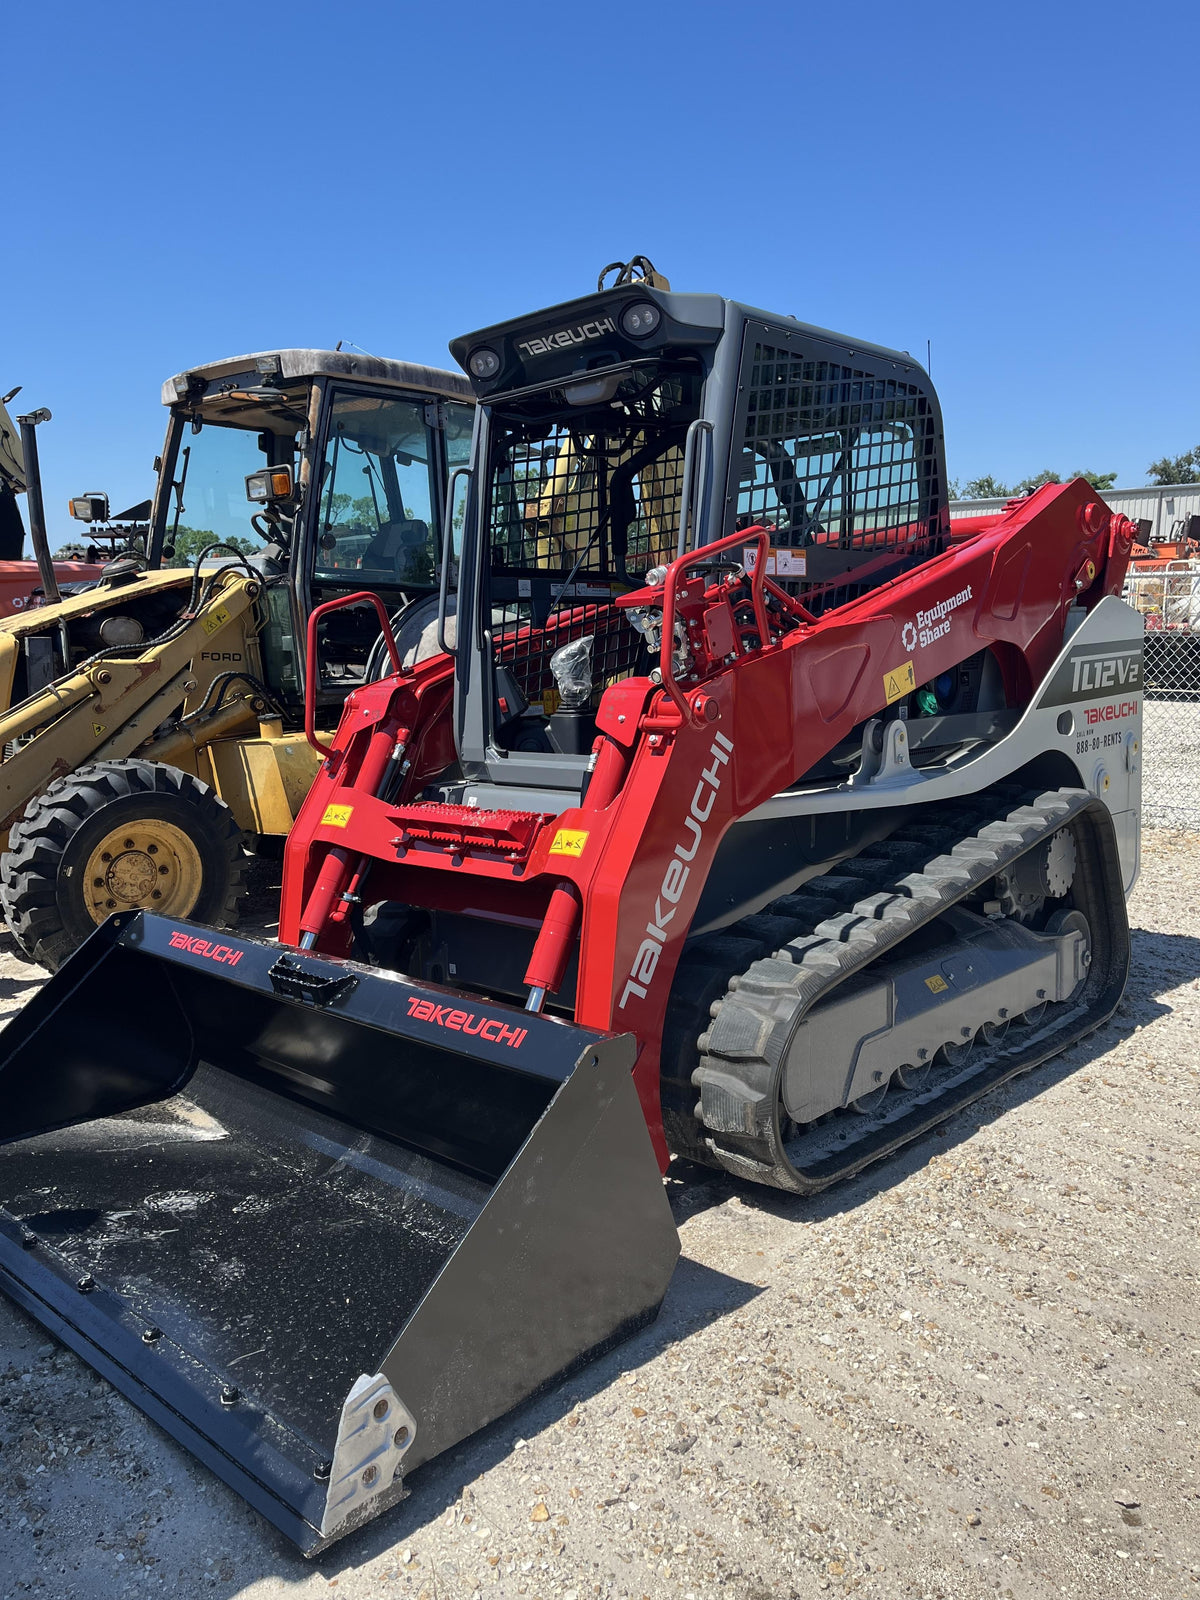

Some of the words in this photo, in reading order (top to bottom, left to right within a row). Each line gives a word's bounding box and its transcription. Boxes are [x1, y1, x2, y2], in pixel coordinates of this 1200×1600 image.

[519, 318, 616, 355] TAKEUCHI
[916, 585, 972, 628] Equipment
[201, 652, 241, 661] FORD
[1071, 649, 1141, 692] TL12V2
[1084, 701, 1137, 724] TAKEUCHI
[1076, 732, 1122, 754] 888-80-RENTS
[619, 731, 734, 1009] TAKEUCHI
[168, 931, 243, 966] TAKEUCHI
[407, 997, 528, 1049] TAKEUCHI
